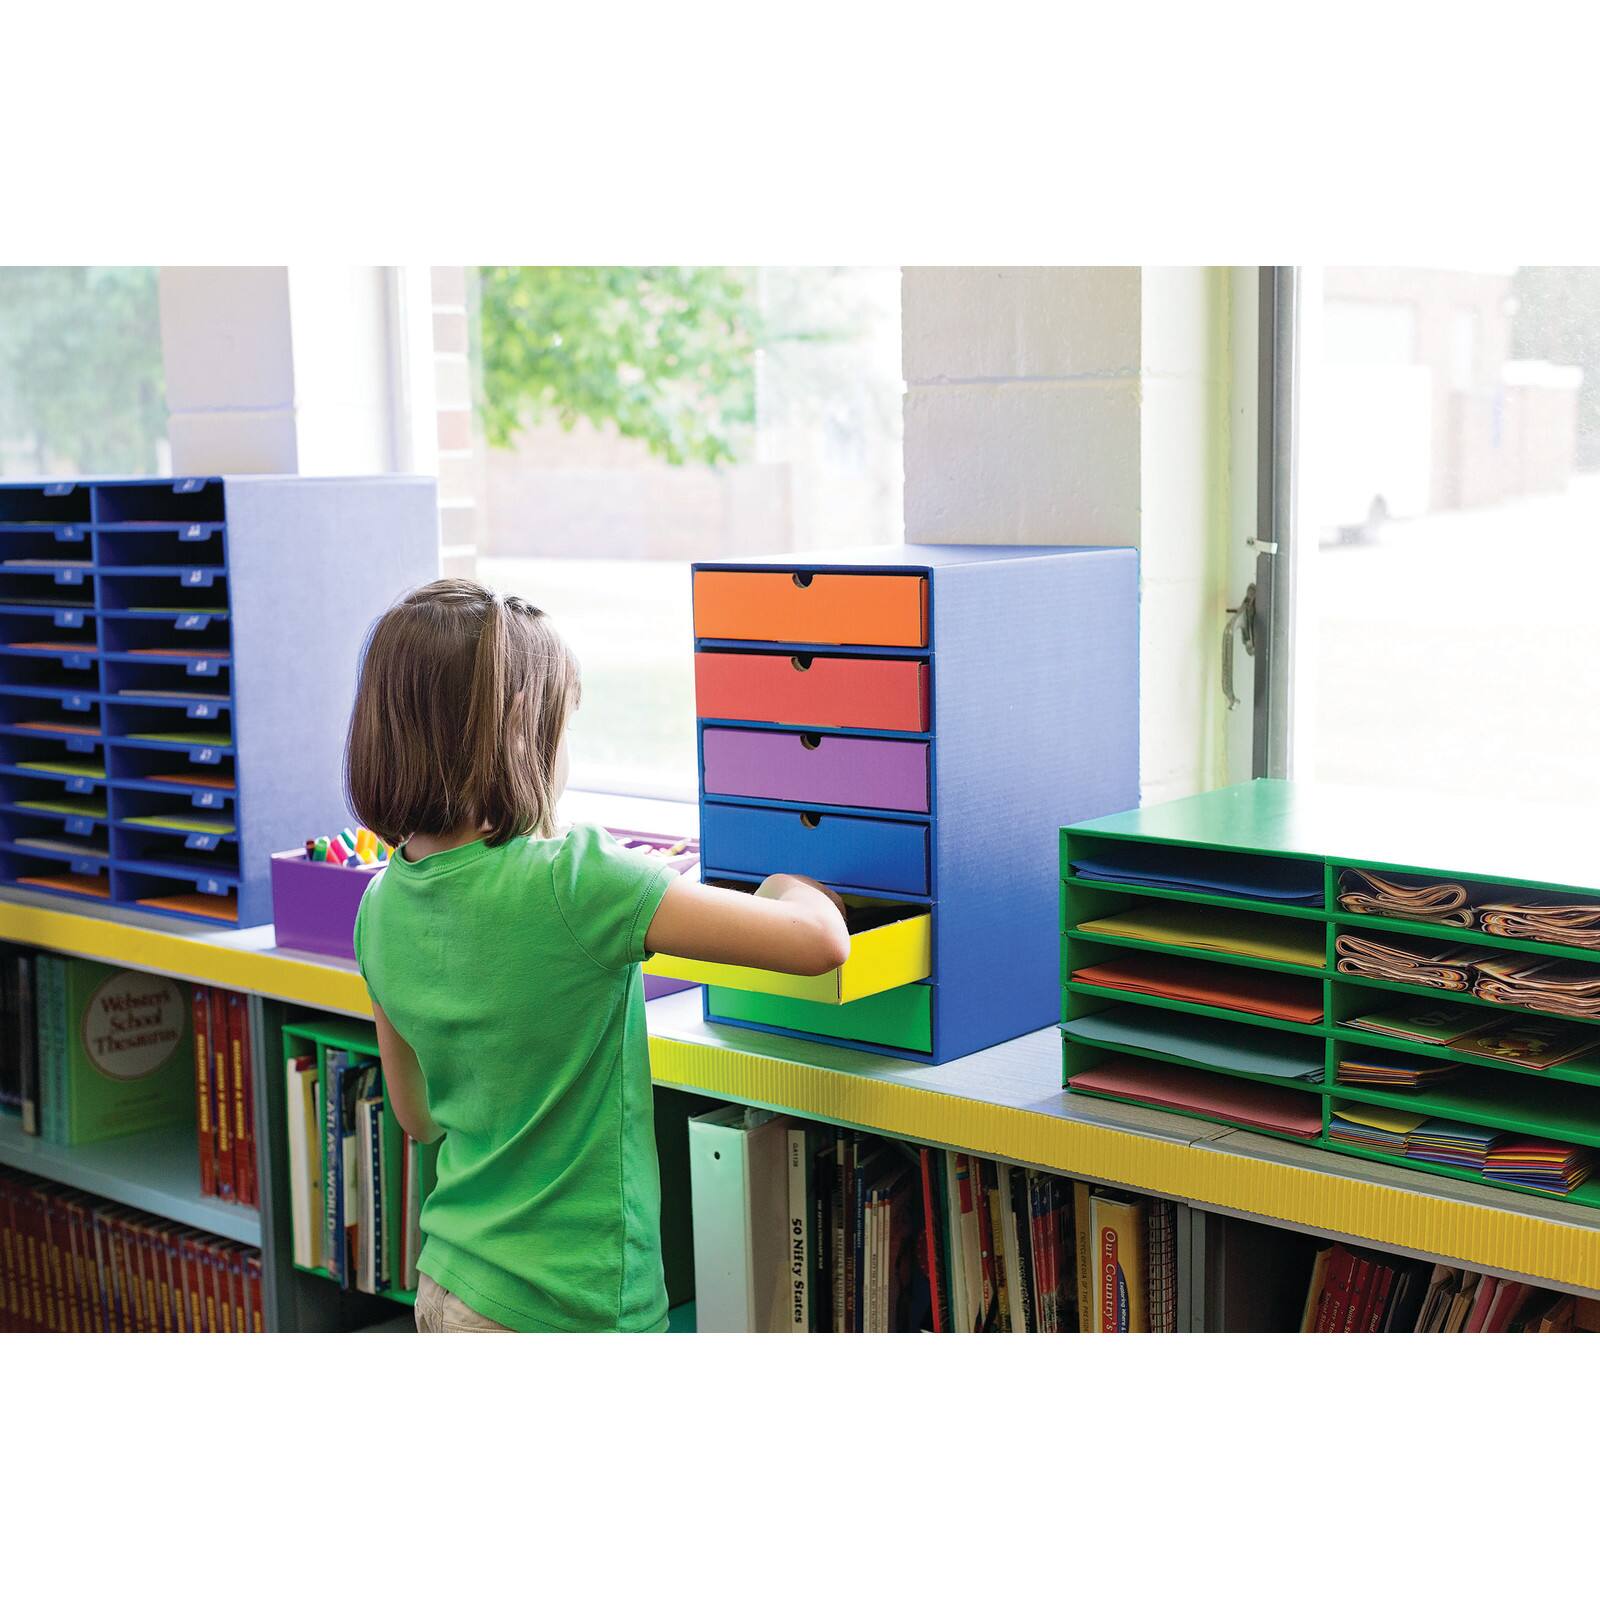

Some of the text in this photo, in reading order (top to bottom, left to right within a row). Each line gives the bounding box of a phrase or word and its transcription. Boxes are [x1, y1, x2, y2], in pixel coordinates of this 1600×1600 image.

[101, 990, 171, 1013] Webster's
[109, 1008, 162, 1031] School
[95, 1030, 178, 1056] Thesaurus
[326, 1100, 338, 1154] ATLAS
[326, 1171, 338, 1231] WORLD
[1079, 1231, 1088, 1279] ENCYCLOPEDIA
[791, 1218, 804, 1324] 50 Nifty States
[1103, 1231, 1117, 1332] Our Country's
[1081, 1281, 1088, 1289] OF
[1119, 1281, 1128, 1308] Exploring
[1120, 1308, 1128, 1326] Where
[1345, 1305, 1356, 1324] Quick
